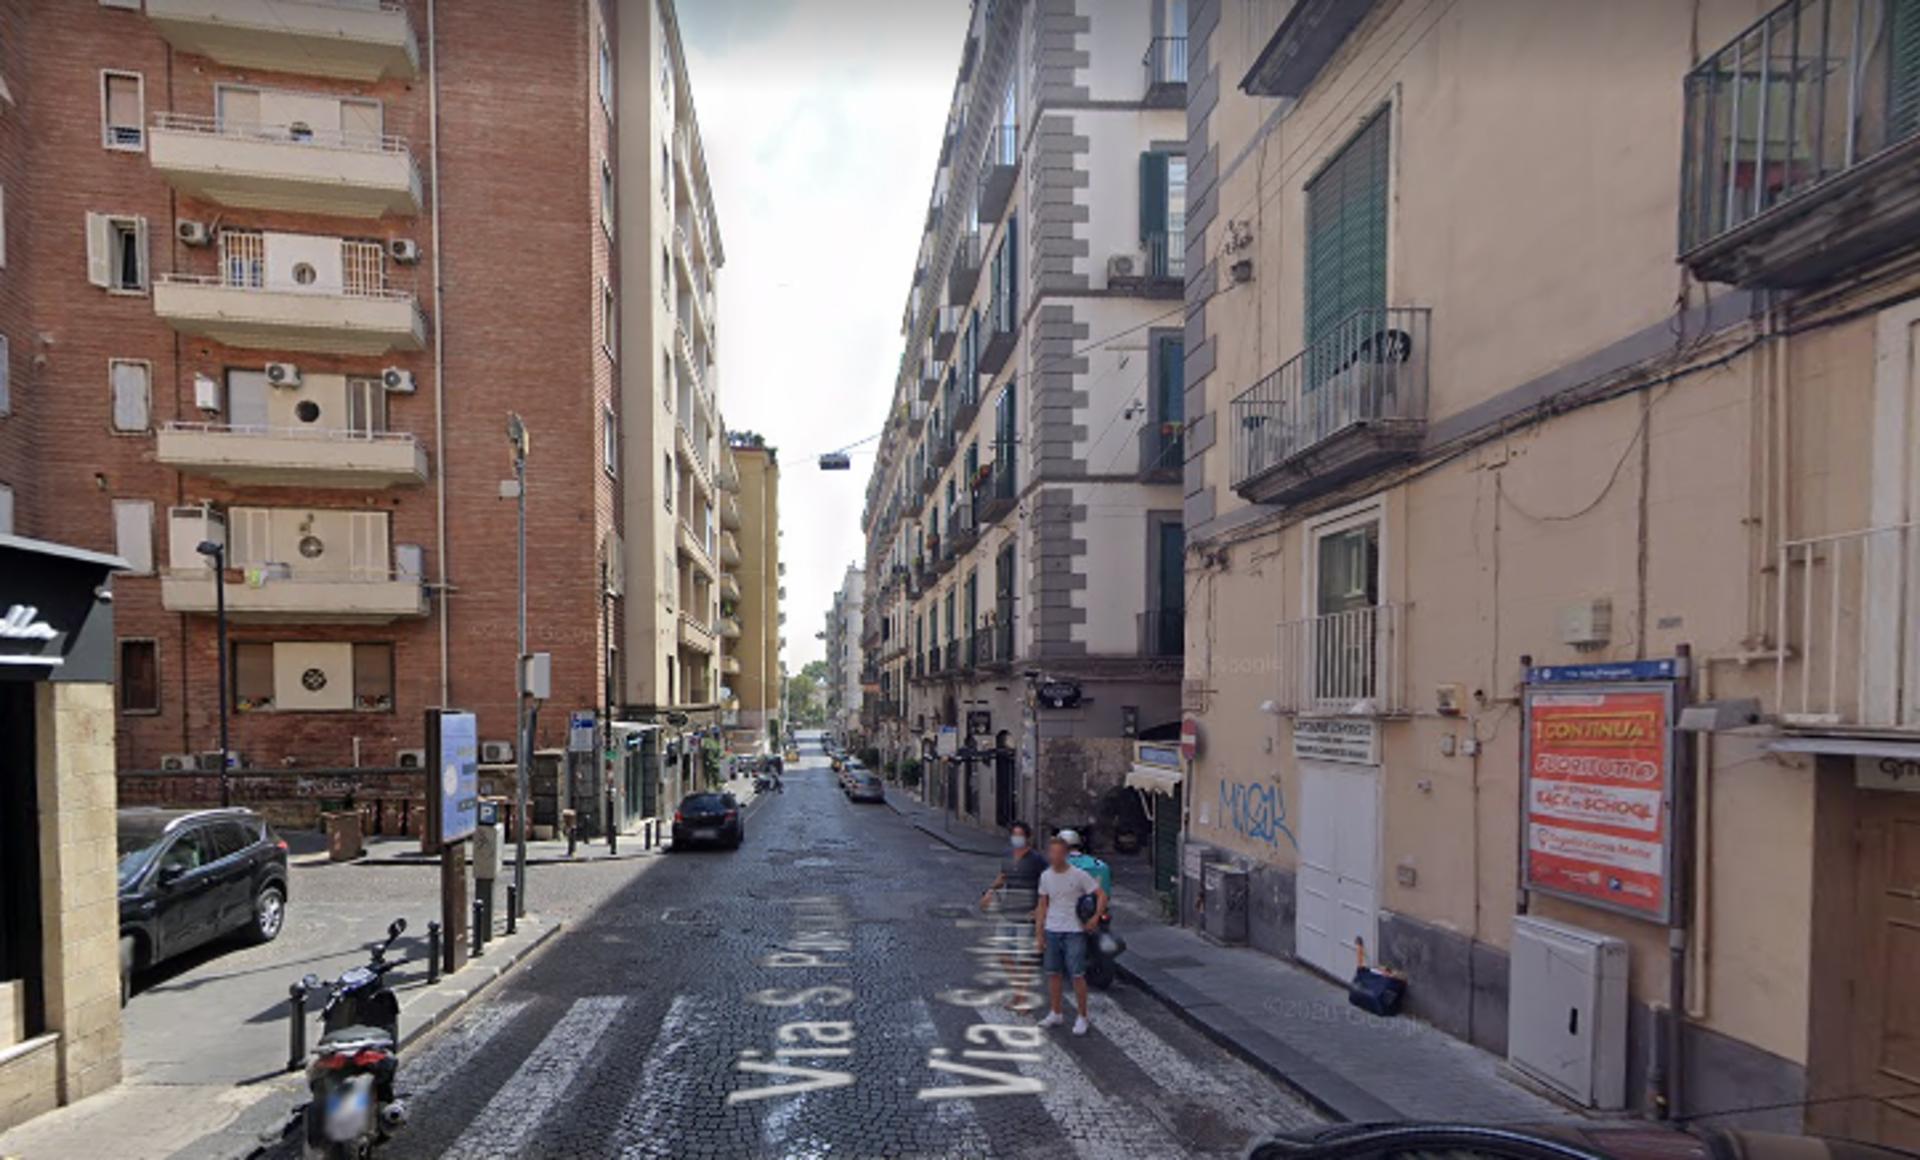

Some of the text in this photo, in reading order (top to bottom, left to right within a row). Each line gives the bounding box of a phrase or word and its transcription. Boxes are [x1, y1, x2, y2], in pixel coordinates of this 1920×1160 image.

[1546, 720, 1643, 740] CONTINUA
[481, 808, 493, 821] P
[1583, 795, 1654, 820] SCHOOL
